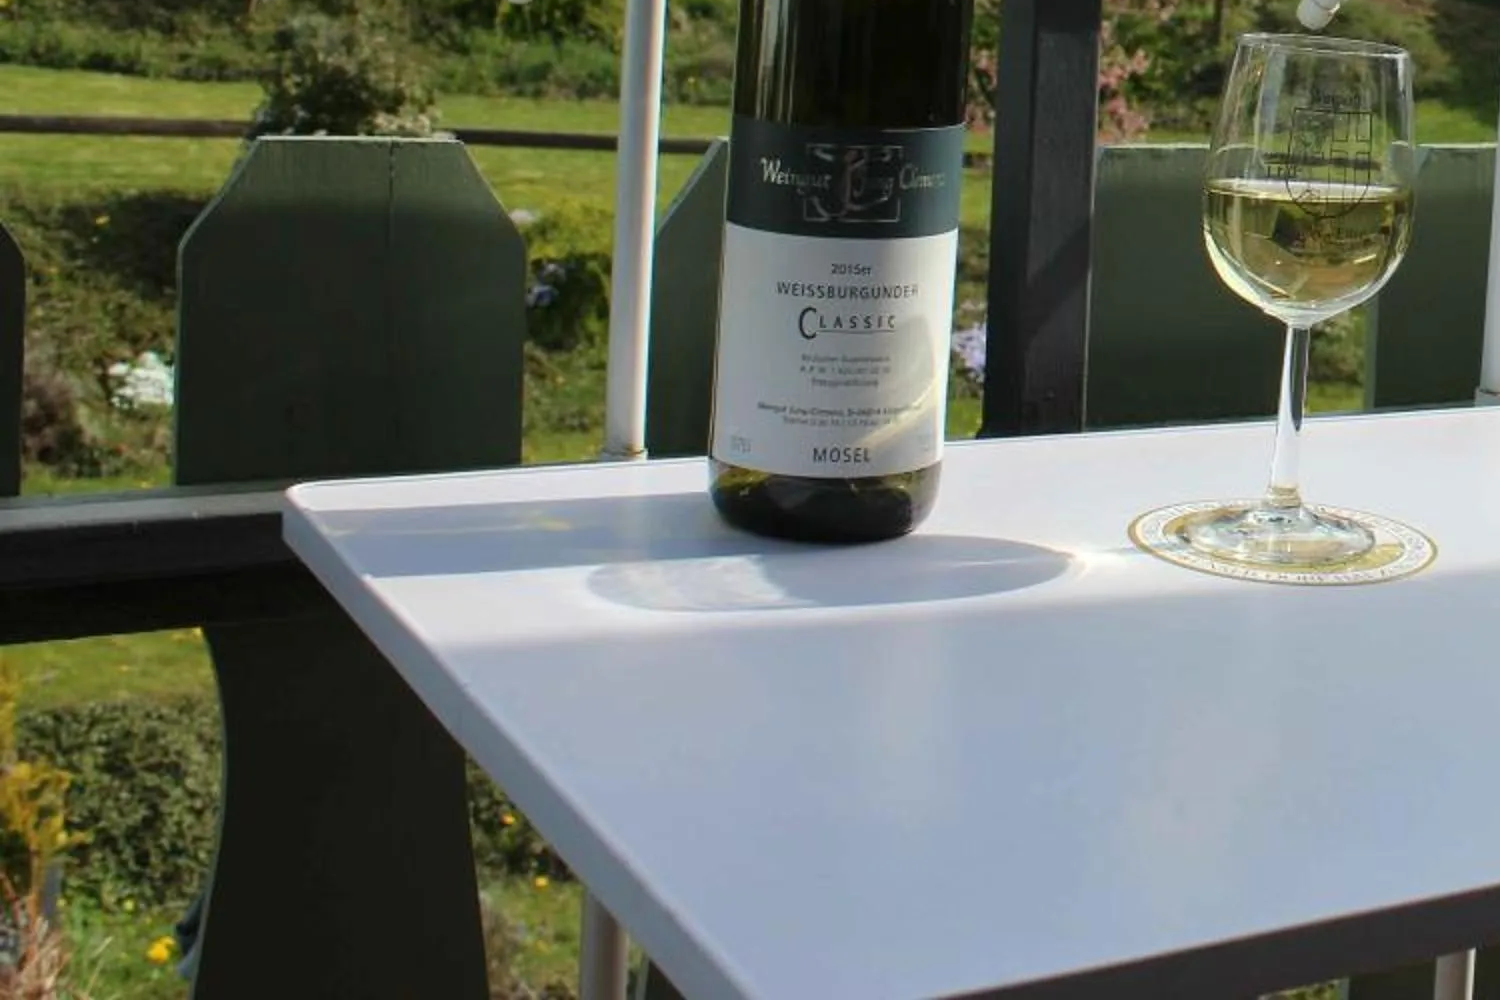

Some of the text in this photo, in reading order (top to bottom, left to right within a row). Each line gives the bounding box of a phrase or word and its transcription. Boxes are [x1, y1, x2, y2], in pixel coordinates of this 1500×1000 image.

[831, 263, 872, 277] 2015er
[777, 281, 919, 300] WEISSBURGUNDER
[813, 447, 872, 464] MOSEL
